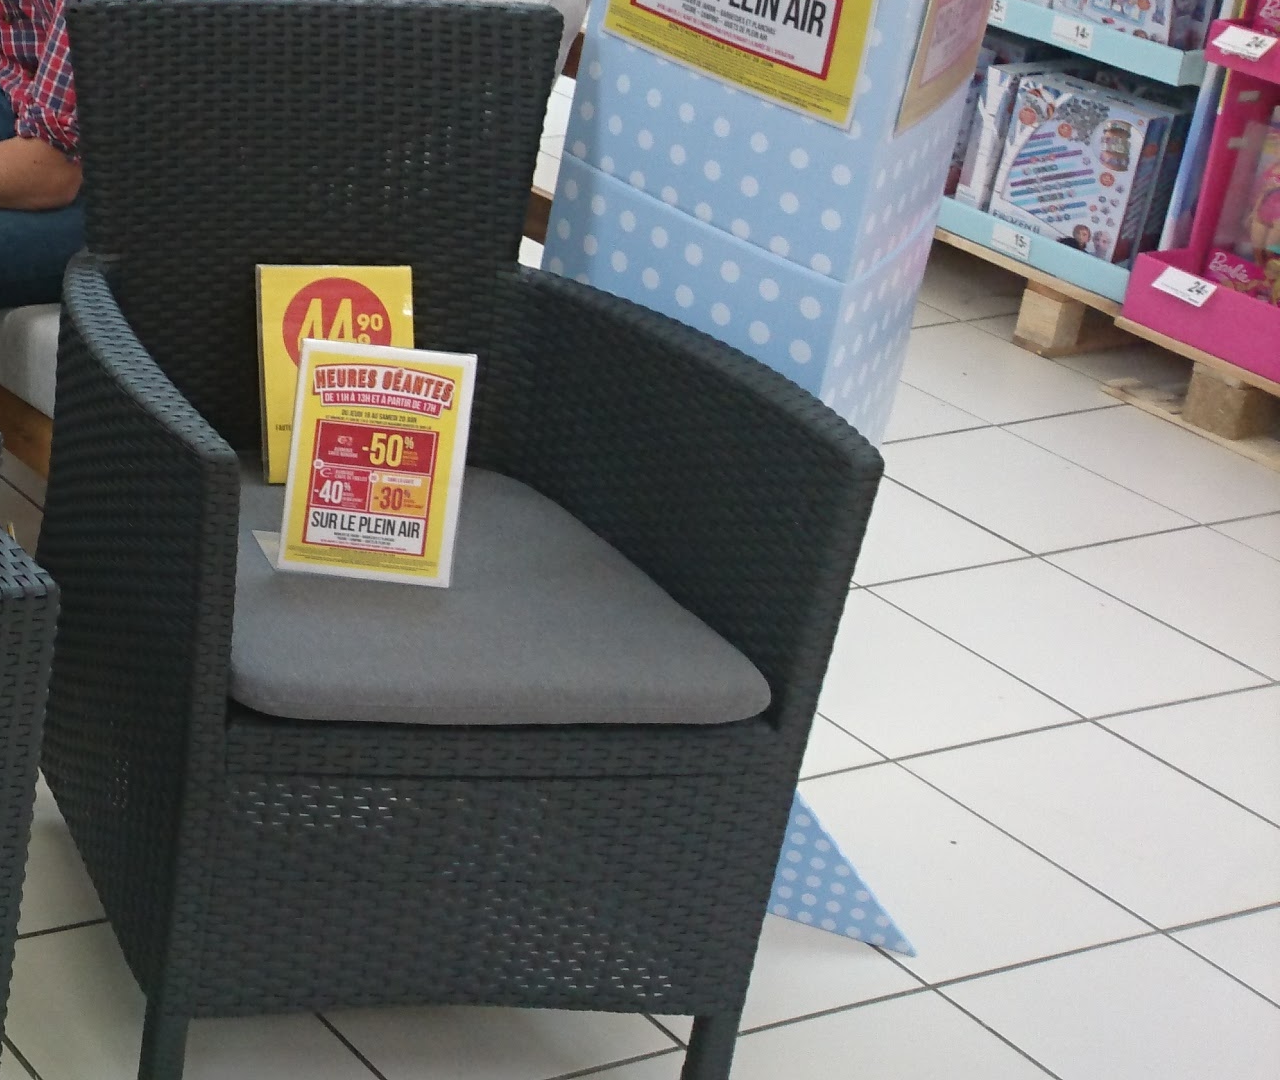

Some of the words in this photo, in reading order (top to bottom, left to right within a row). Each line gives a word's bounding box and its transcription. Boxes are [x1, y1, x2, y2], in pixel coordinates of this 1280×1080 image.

[1209, 251, 1251, 283] Barbie
[315, 369, 378, 388] HEURES
[381, 368, 454, 402] GÉANTES
[325, 393, 334, 402] DE
[336, 393, 349, 402] 11H
[350, 392, 355, 401] À
[357, 394, 370, 403] 13H
[371, 395, 380, 403] ET
[380, 394, 386, 404] À
[386, 396, 411, 407] PARTIR
[412, 400, 422, 410] DE
[423, 403, 437, 412] 17H
[362, 432, 415, 467] -50%
[314, 479, 351, 504] -40%
[374, 486, 411, 510] -30%
[311, 511, 338, 529] SUR
[340, 514, 356, 532] LE
[358, 517, 396, 536] PLEIN
[398, 521, 420, 539] AIR
